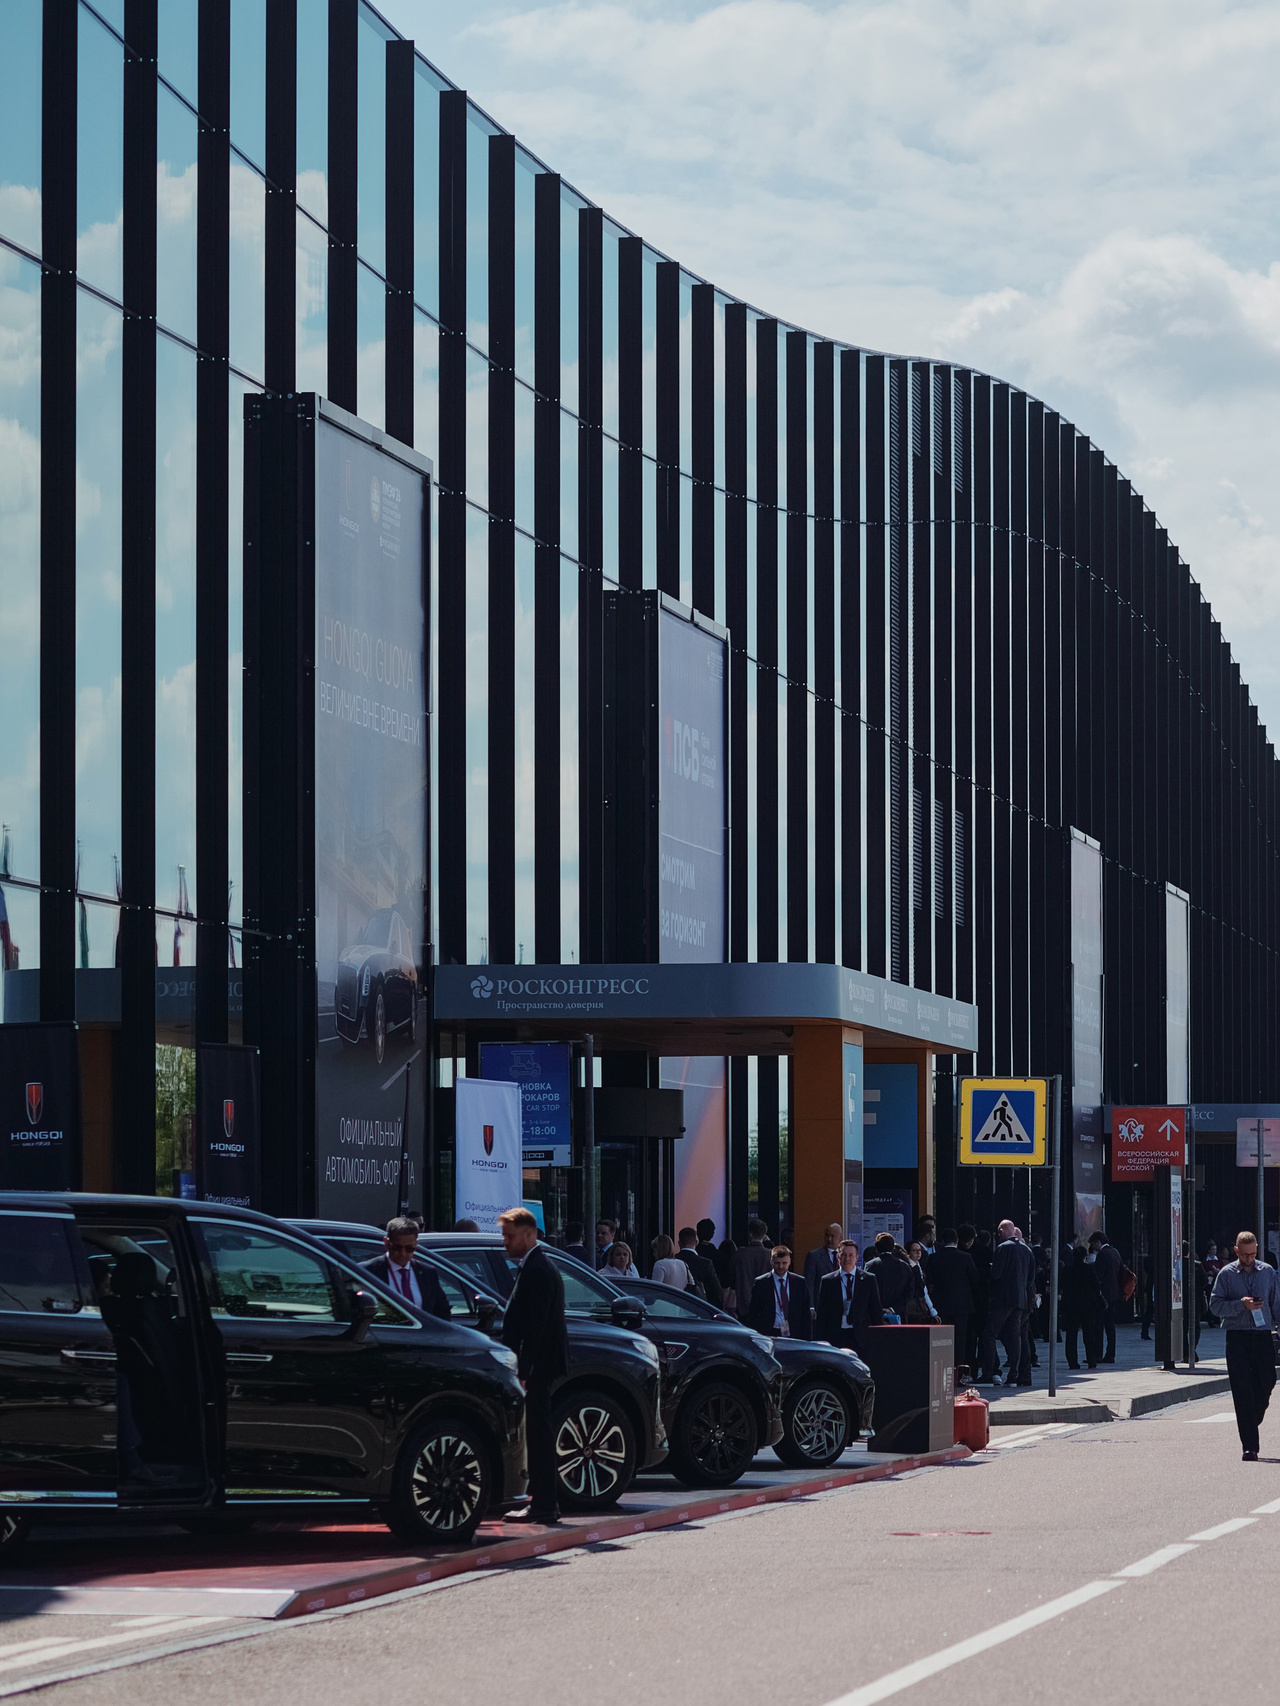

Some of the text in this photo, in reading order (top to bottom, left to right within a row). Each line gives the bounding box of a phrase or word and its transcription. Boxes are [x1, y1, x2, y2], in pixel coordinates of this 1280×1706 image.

[324, 614, 415, 694] HONGQI GUOYA
[320, 681, 420, 746] ВЕЛИЧИЕ ВНЕ ВРЕМЕНИ
[673, 719, 700, 782] ПСБ
[661, 852, 696, 894] смотрим
[671, 911, 706, 949] горизонт
[497, 978, 649, 995] РОСКОНГРЕСС
[497, 1001, 604, 1012] Пространство доверия
[521, 1082, 552, 1091] НОВКА
[521, 1093, 560, 1102] РОКАРОВ
[526, 1104, 560, 1112] CAR STOP
[10, 1130, 63, 1140] HONGQI
[340, 1117, 402, 1150] ОФИЦИАЛЬНЫЙ
[520, 1126, 557, 1136] –18:00
[210, 1142, 245, 1152] HONGQI
[471, 1159, 508, 1169] HONGQI
[325, 1155, 415, 1186] АВТОМОБИЛЬ ФОРА
[469, 1215, 497, 1224] автомоб
